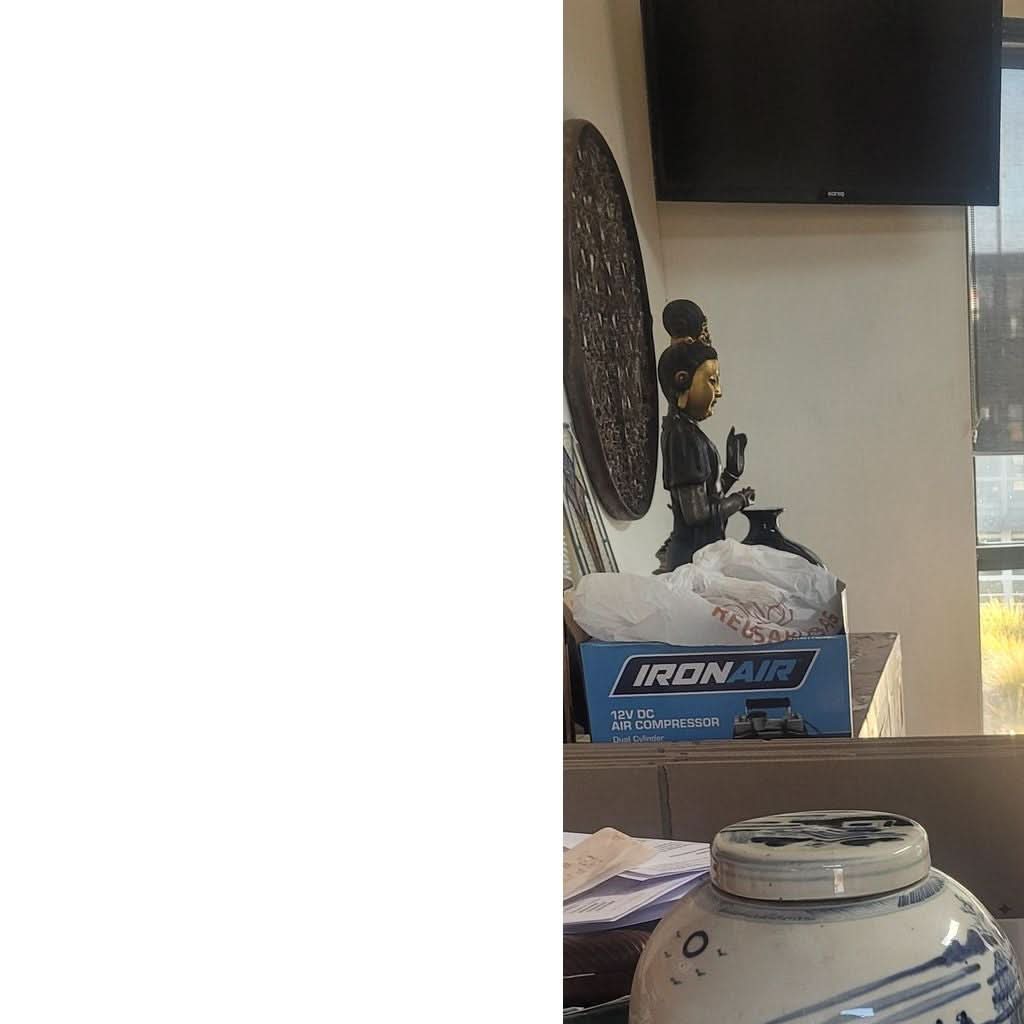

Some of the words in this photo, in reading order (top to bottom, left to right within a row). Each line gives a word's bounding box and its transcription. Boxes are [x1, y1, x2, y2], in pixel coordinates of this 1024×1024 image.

[611, 710, 634, 720] 12V
[637, 709, 655, 719] DC
[611, 721, 632, 731] AIR
[635, 717, 720, 730] COMPRESSOR
[612, 735, 631, 743] Dual
[633, 734, 664, 743] Cylinder
